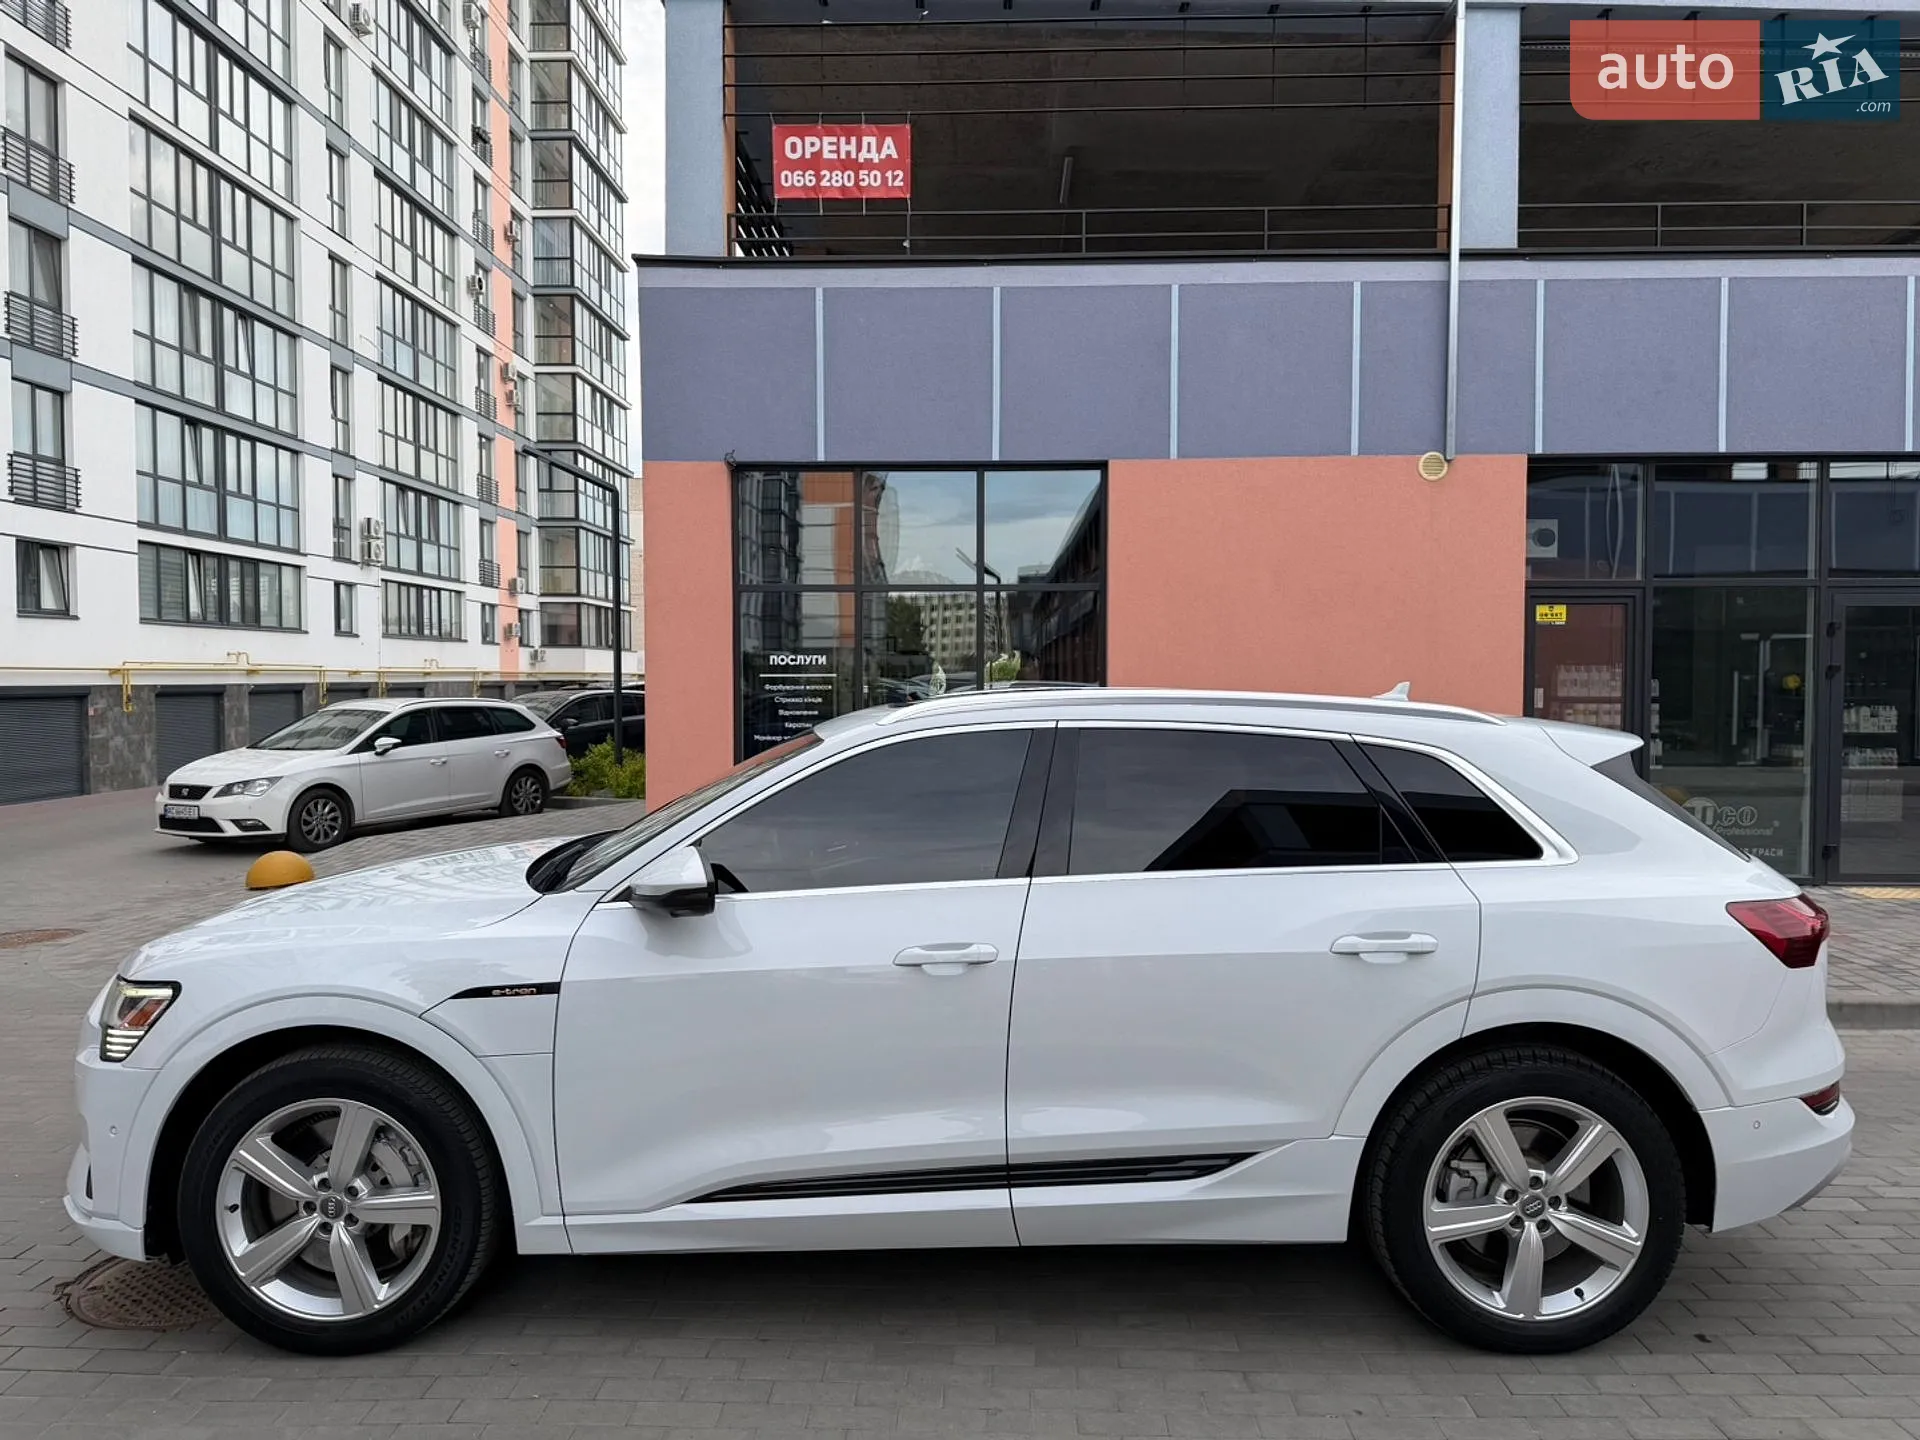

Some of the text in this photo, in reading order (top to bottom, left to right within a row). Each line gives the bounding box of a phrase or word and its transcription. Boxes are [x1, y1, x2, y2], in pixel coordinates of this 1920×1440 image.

[784, 136, 898, 163] ОРЕНДА
[780, 170, 904, 187] 066 280 50 12
[769, 655, 827, 666] ПОСЛУГИ
[491, 987, 537, 996] e-tron
